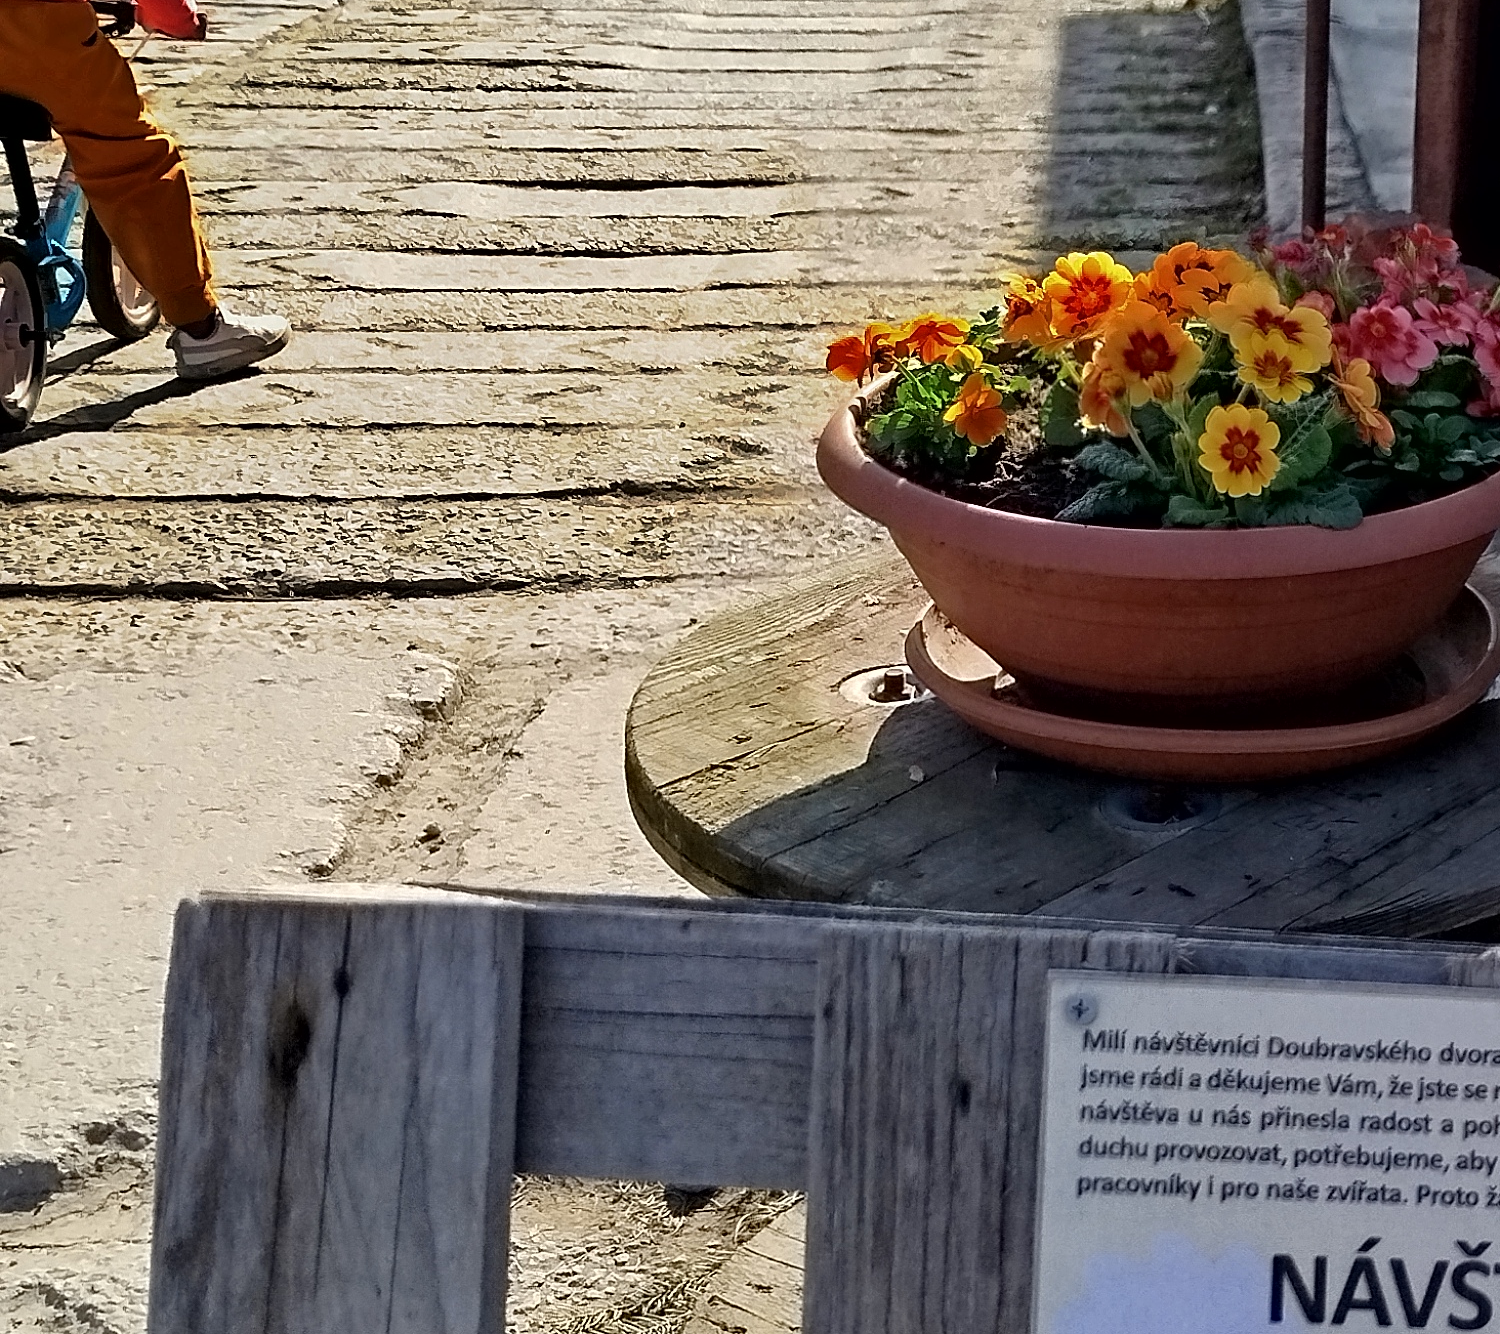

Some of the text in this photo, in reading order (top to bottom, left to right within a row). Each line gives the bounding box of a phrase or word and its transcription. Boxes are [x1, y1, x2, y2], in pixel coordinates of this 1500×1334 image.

[1082, 1028, 1127, 1053] Milí
[1132, 1030, 1260, 1058] návštěvníci
[1266, 1036, 1432, 1064] Doubravského
[1079, 1063, 1135, 1090] jsme
[1139, 1065, 1184, 1090] rádi
[1187, 1072, 1202, 1091] a
[1206, 1067, 1321, 1097] děkujeme
[1325, 1072, 1383, 1101] Vám,
[1387, 1074, 1413, 1098] že
[1415, 1076, 1459, 1104] jste
[1462, 1083, 1488, 1101] se
[1079, 1099, 1179, 1125] návštěva
[1187, 1108, 1203, 1126] u
[1211, 1103, 1251, 1128] nás
[1258, 1105, 1350, 1131] přinesla
[1358, 1110, 1433, 1135] radost
[1439, 1118, 1454, 1135] a
[1077, 1134, 1149, 1159] duchu
[1153, 1143, 1287, 1168] provozovat,
[1292, 1143, 1449, 1175] potřebujeme,
[1454, 1149, 1498, 1178] aby
[1076, 1173, 1201, 1203] pracovníky
[1207, 1175, 1214, 1198] i
[1219, 1181, 1260, 1204] pro
[1265, 1177, 1319, 1202] naše
[1325, 1179, 1407, 1205] zvířata.
[1415, 1184, 1479, 1208] Proto
